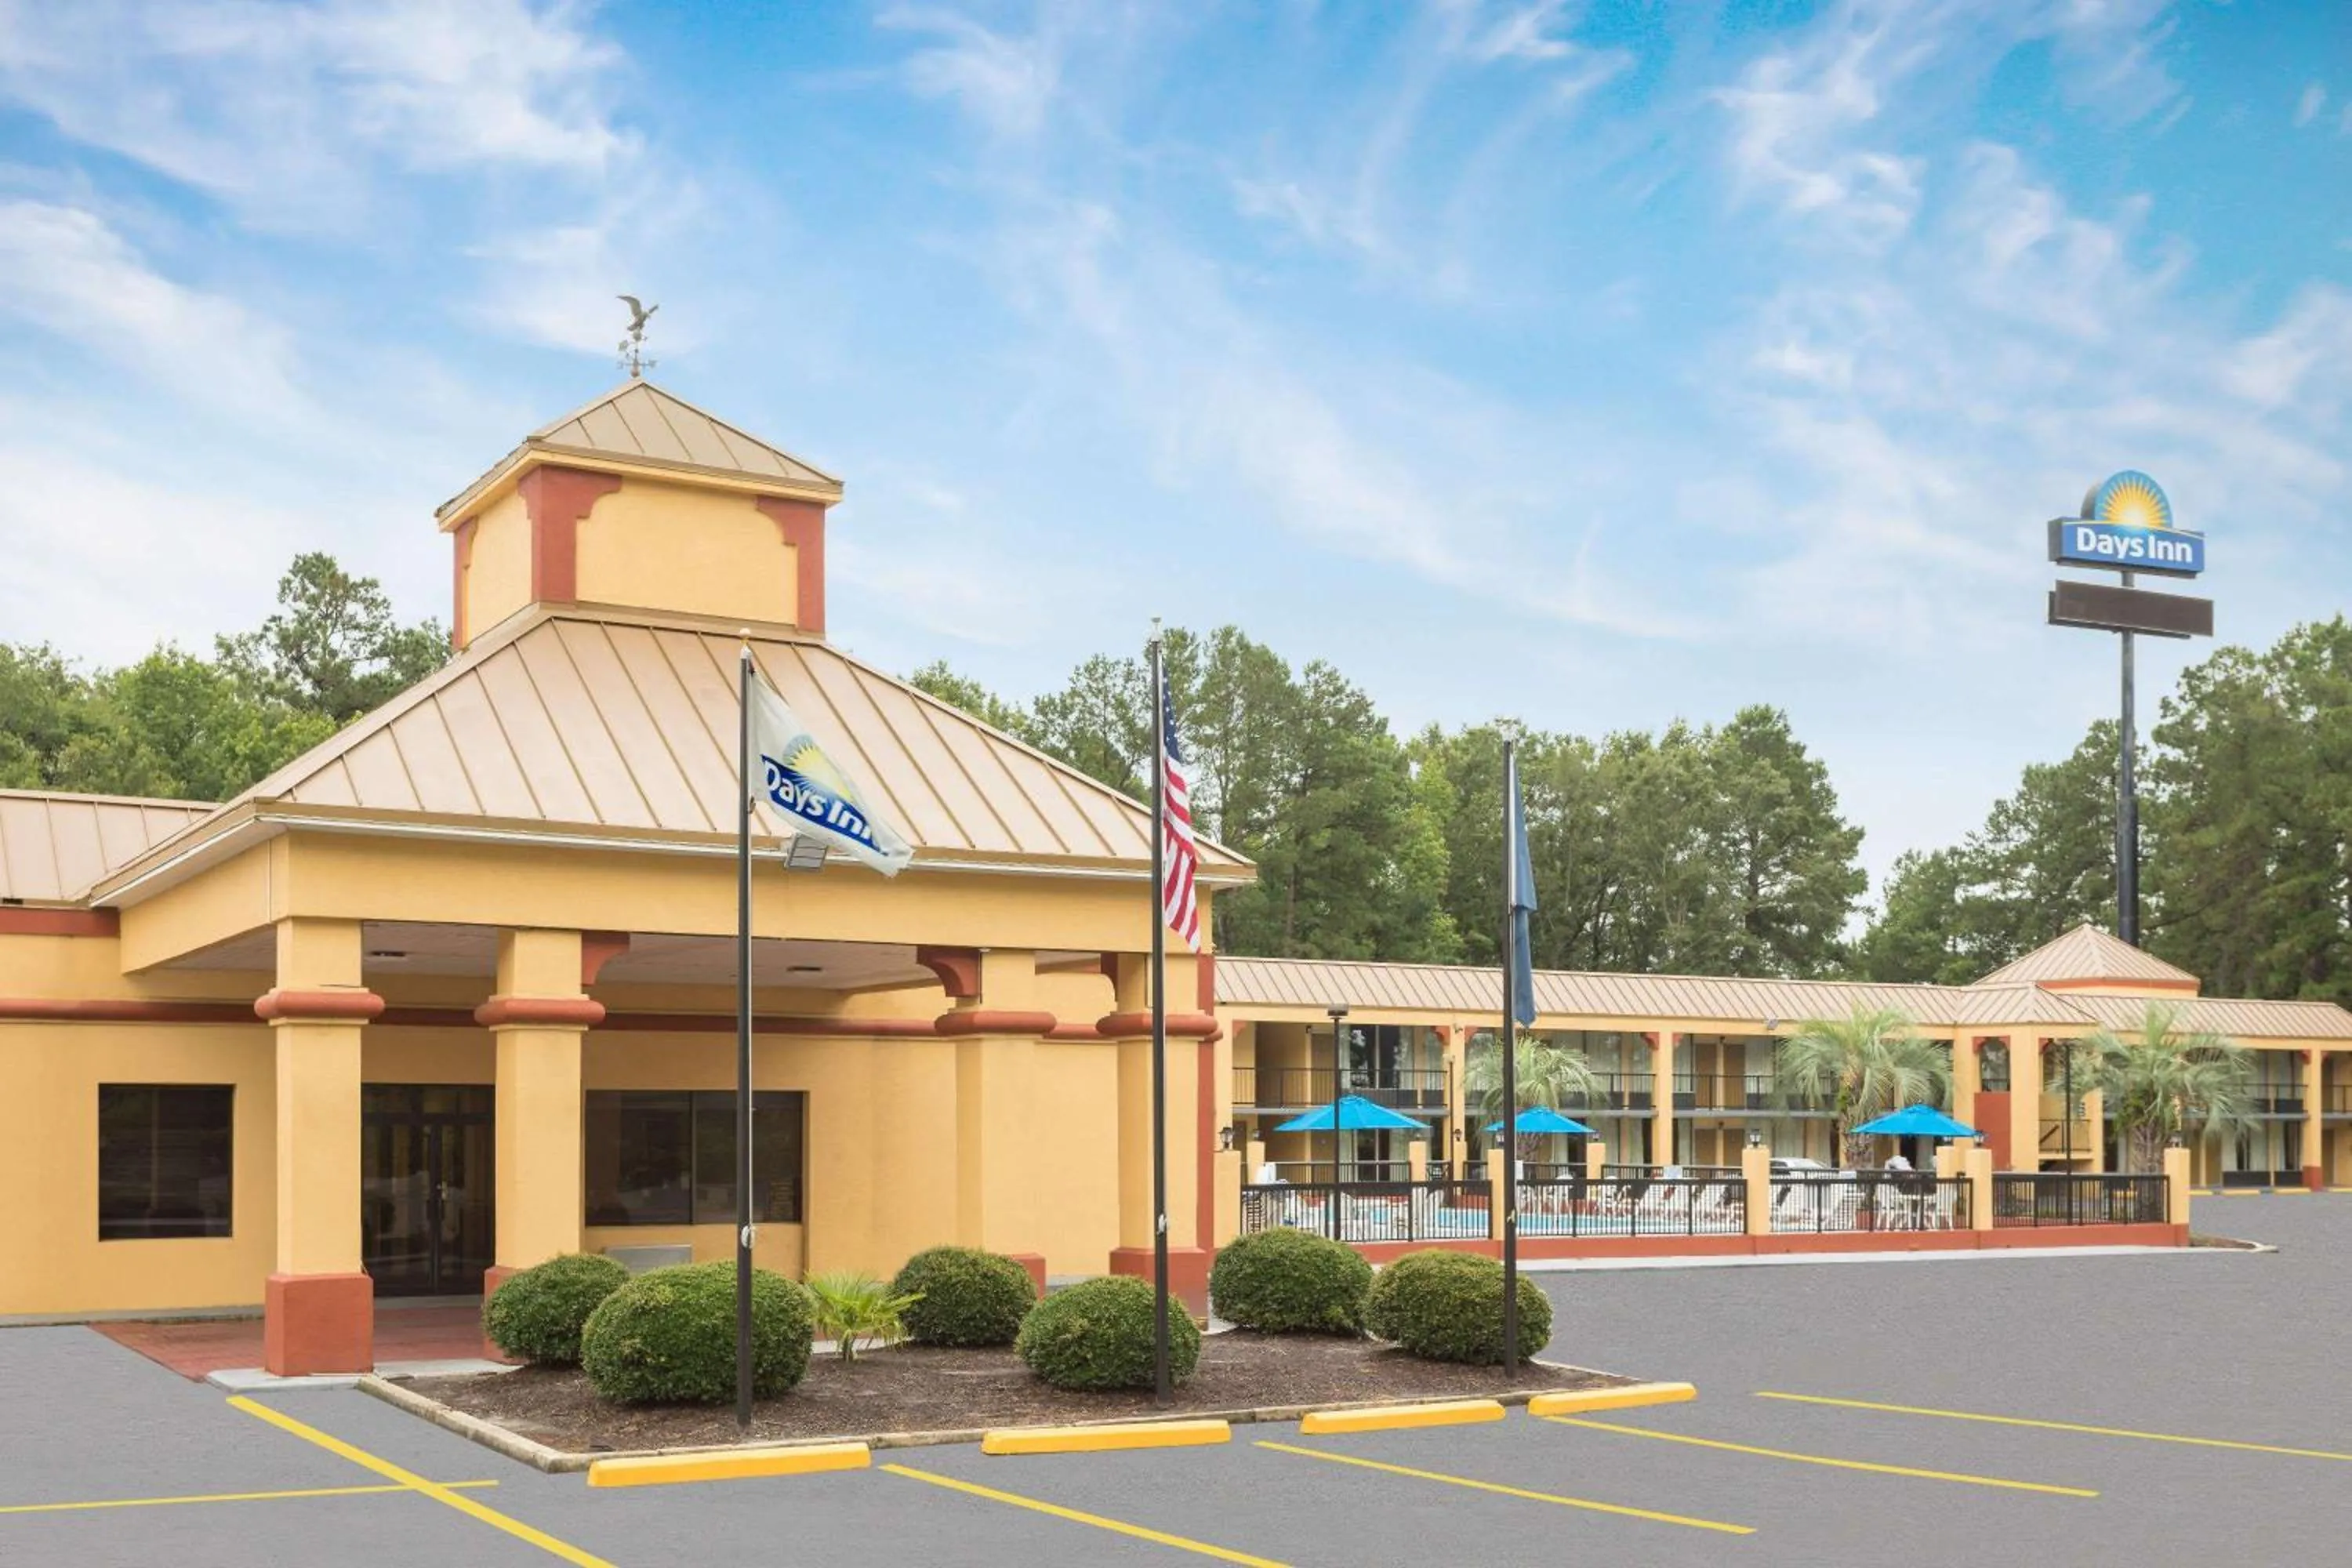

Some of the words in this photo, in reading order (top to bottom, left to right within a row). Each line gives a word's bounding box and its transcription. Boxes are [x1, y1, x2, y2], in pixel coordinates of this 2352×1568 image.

[2076, 526, 2145, 560] Days
[2147, 534, 2193, 563] Inn
[764, 760, 827, 817] Days
